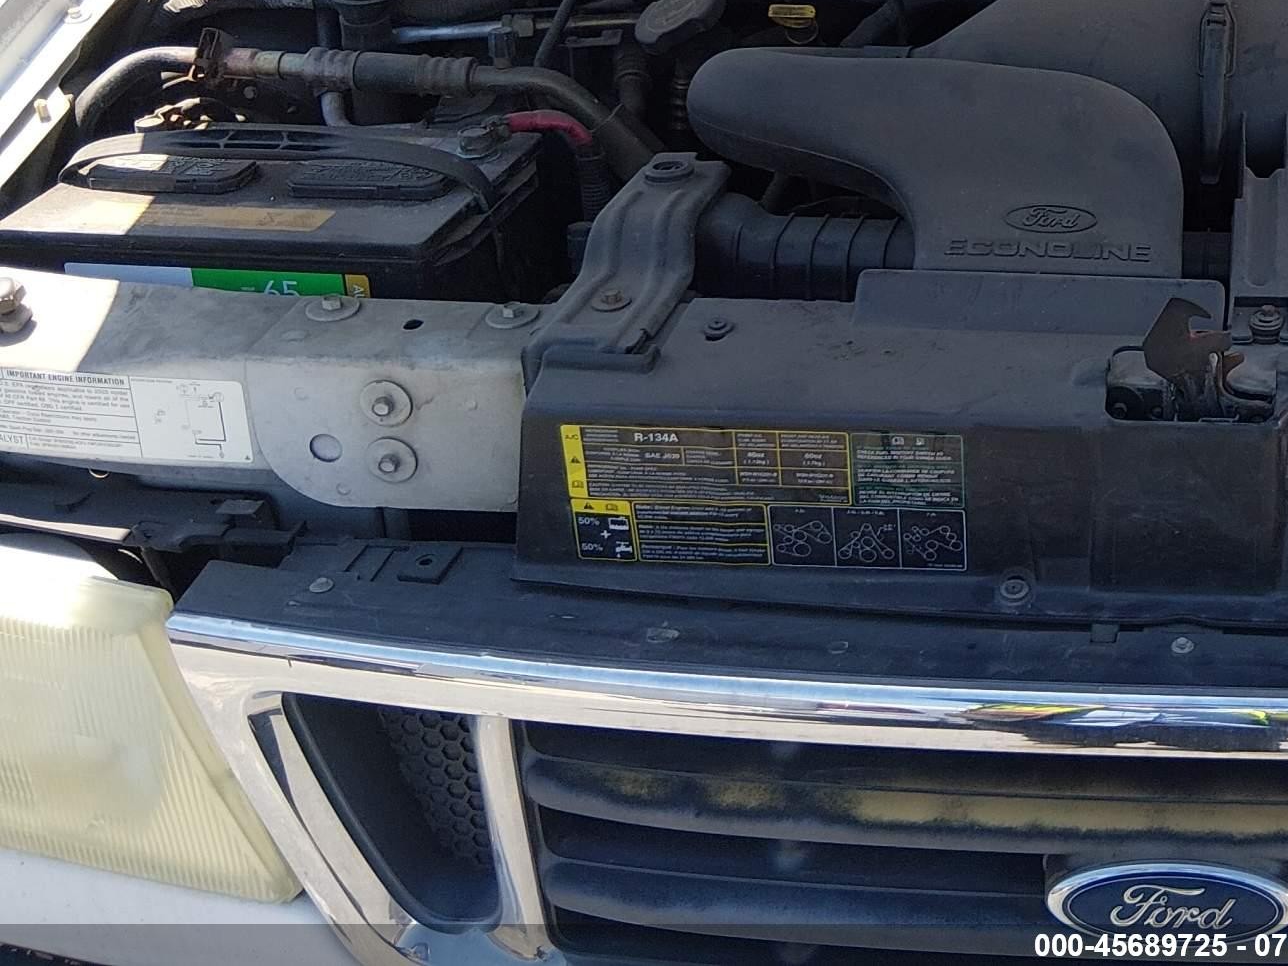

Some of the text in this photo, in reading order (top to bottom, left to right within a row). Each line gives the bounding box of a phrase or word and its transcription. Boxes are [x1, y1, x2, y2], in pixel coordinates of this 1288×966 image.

[1023, 208, 1080, 228] Ford
[944, 238, 1151, 262] ECONOLINE
[7, 370, 46, 380] IMPORTANT
[48, 374, 73, 382] ENGINE
[76, 376, 124, 385] INFORMATION
[0, 434, 23, 444] ALYST
[634, 432, 679, 443] R-134A
[578, 517, 600, 526] 50%
[581, 543, 603, 552] 50%
[1110, 884, 1237, 930] Ford
